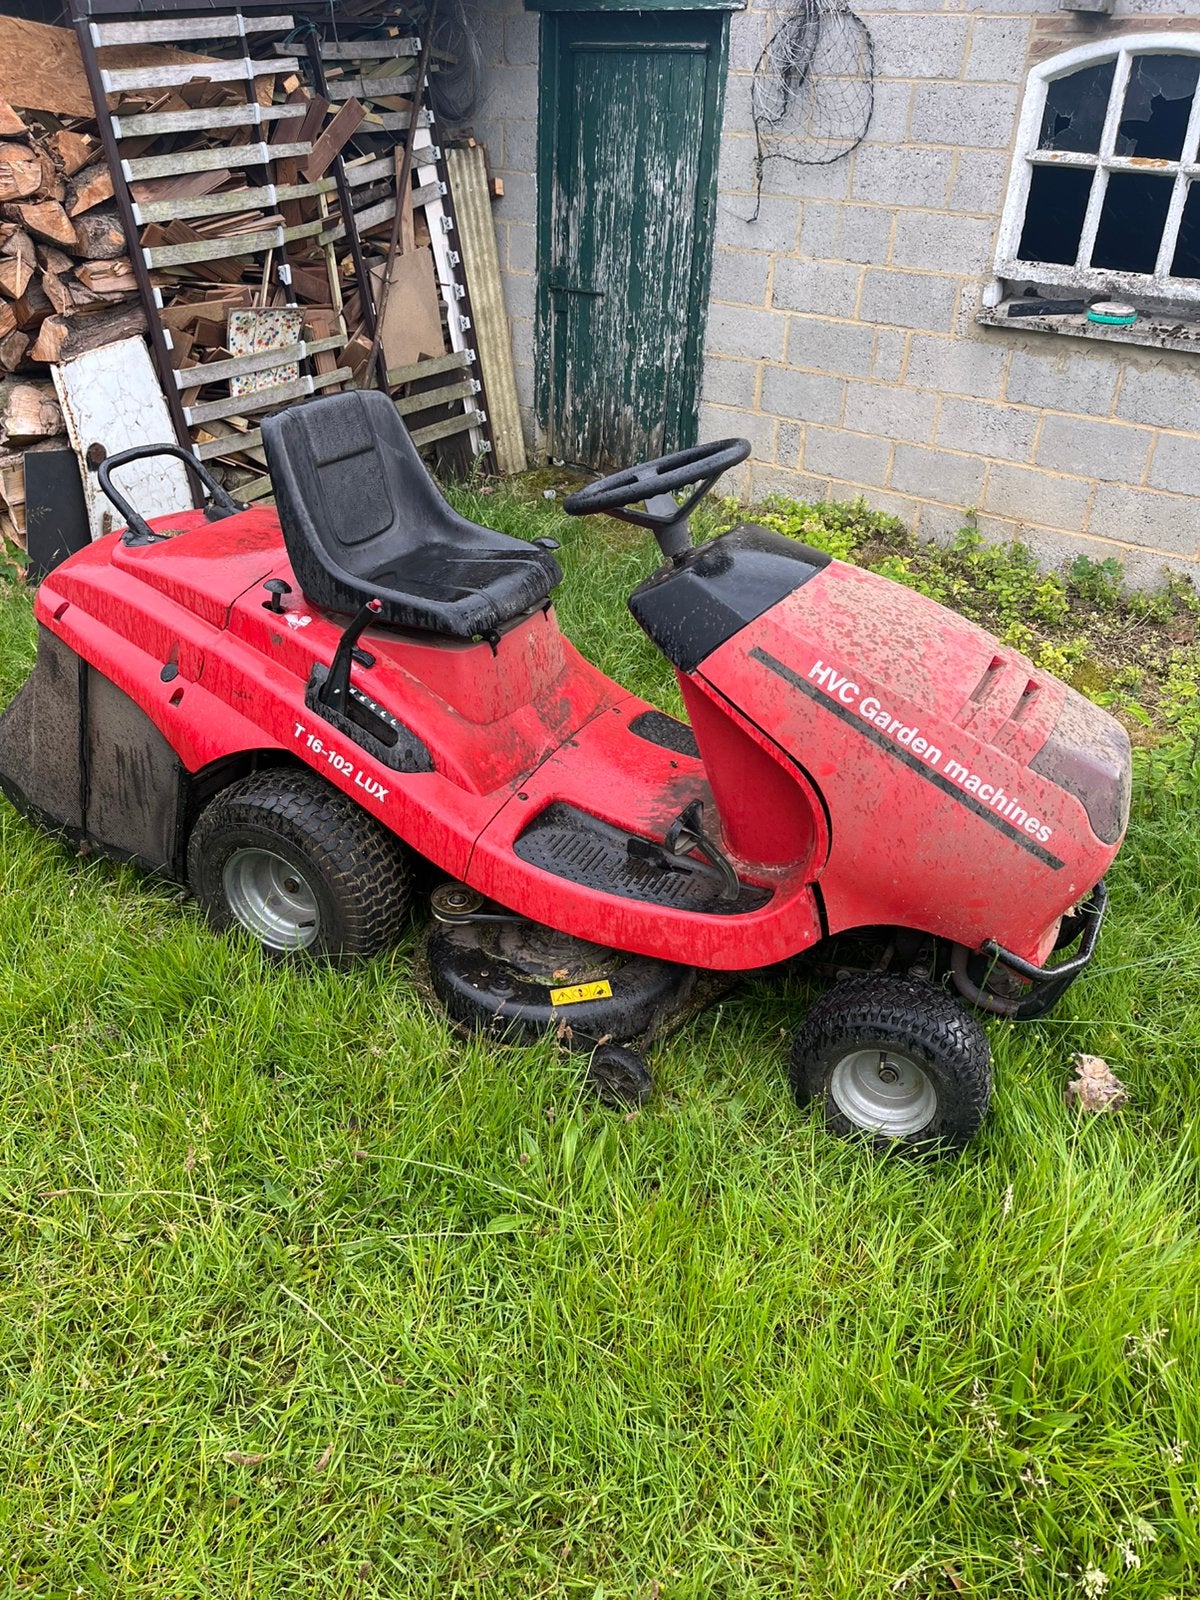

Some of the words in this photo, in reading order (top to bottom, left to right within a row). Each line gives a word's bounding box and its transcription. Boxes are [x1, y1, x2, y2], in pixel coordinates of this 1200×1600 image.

[294, 722, 306, 738] T
[306, 734, 354, 777] 16-102
[354, 770, 390, 803] LUX
[807, 659, 861, 703] HVC
[858, 697, 943, 765] Garden
[943, 758, 1053, 843] machines
